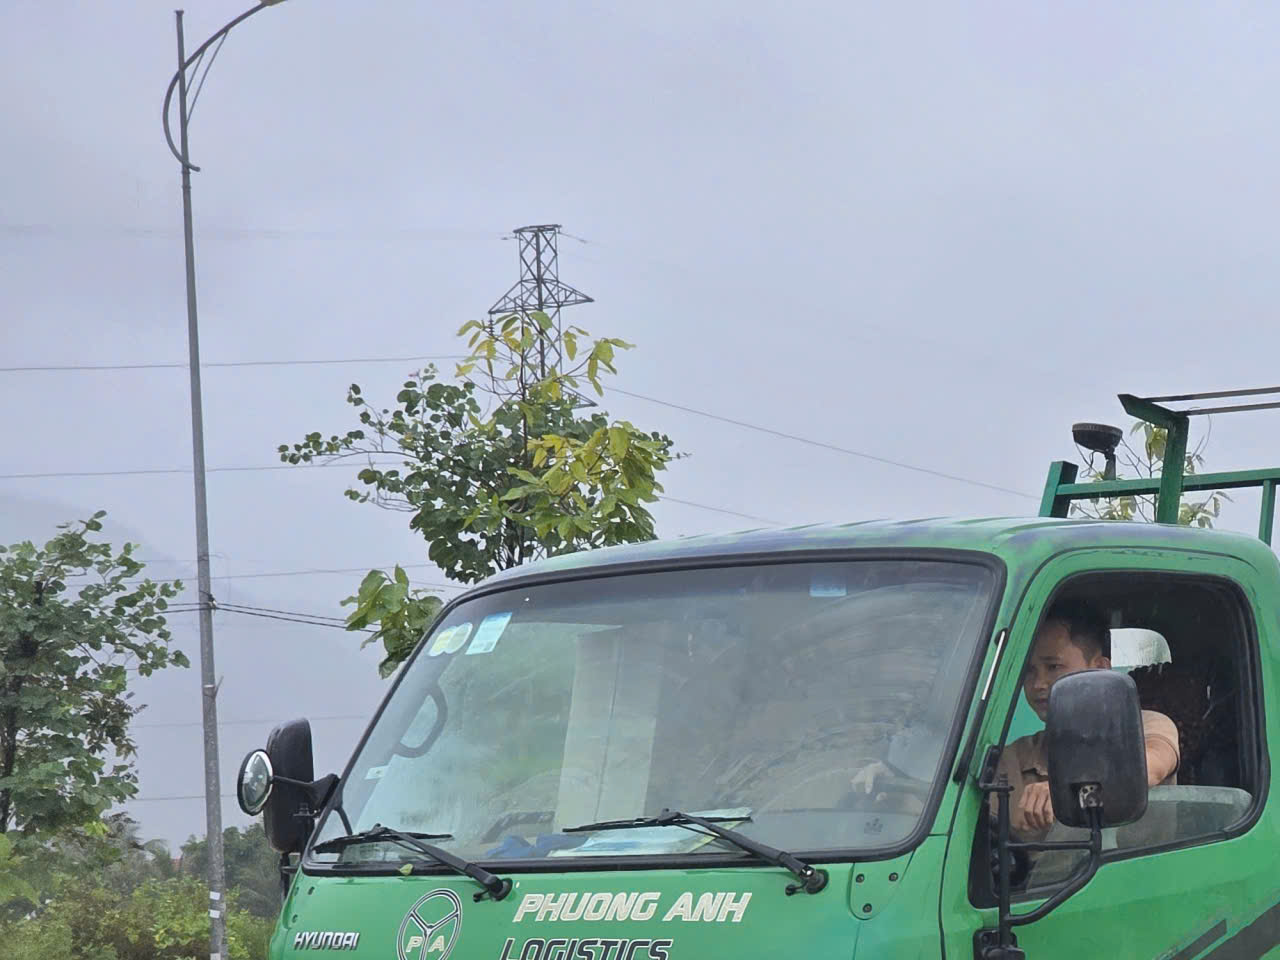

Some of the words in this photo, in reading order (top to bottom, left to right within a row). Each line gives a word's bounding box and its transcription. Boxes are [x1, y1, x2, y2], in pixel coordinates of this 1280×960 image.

[662, 892, 752, 923] ANH
[294, 931, 358, 950] HYUNDAI
[406, 936, 423, 952] P
[428, 936, 444, 952] A
